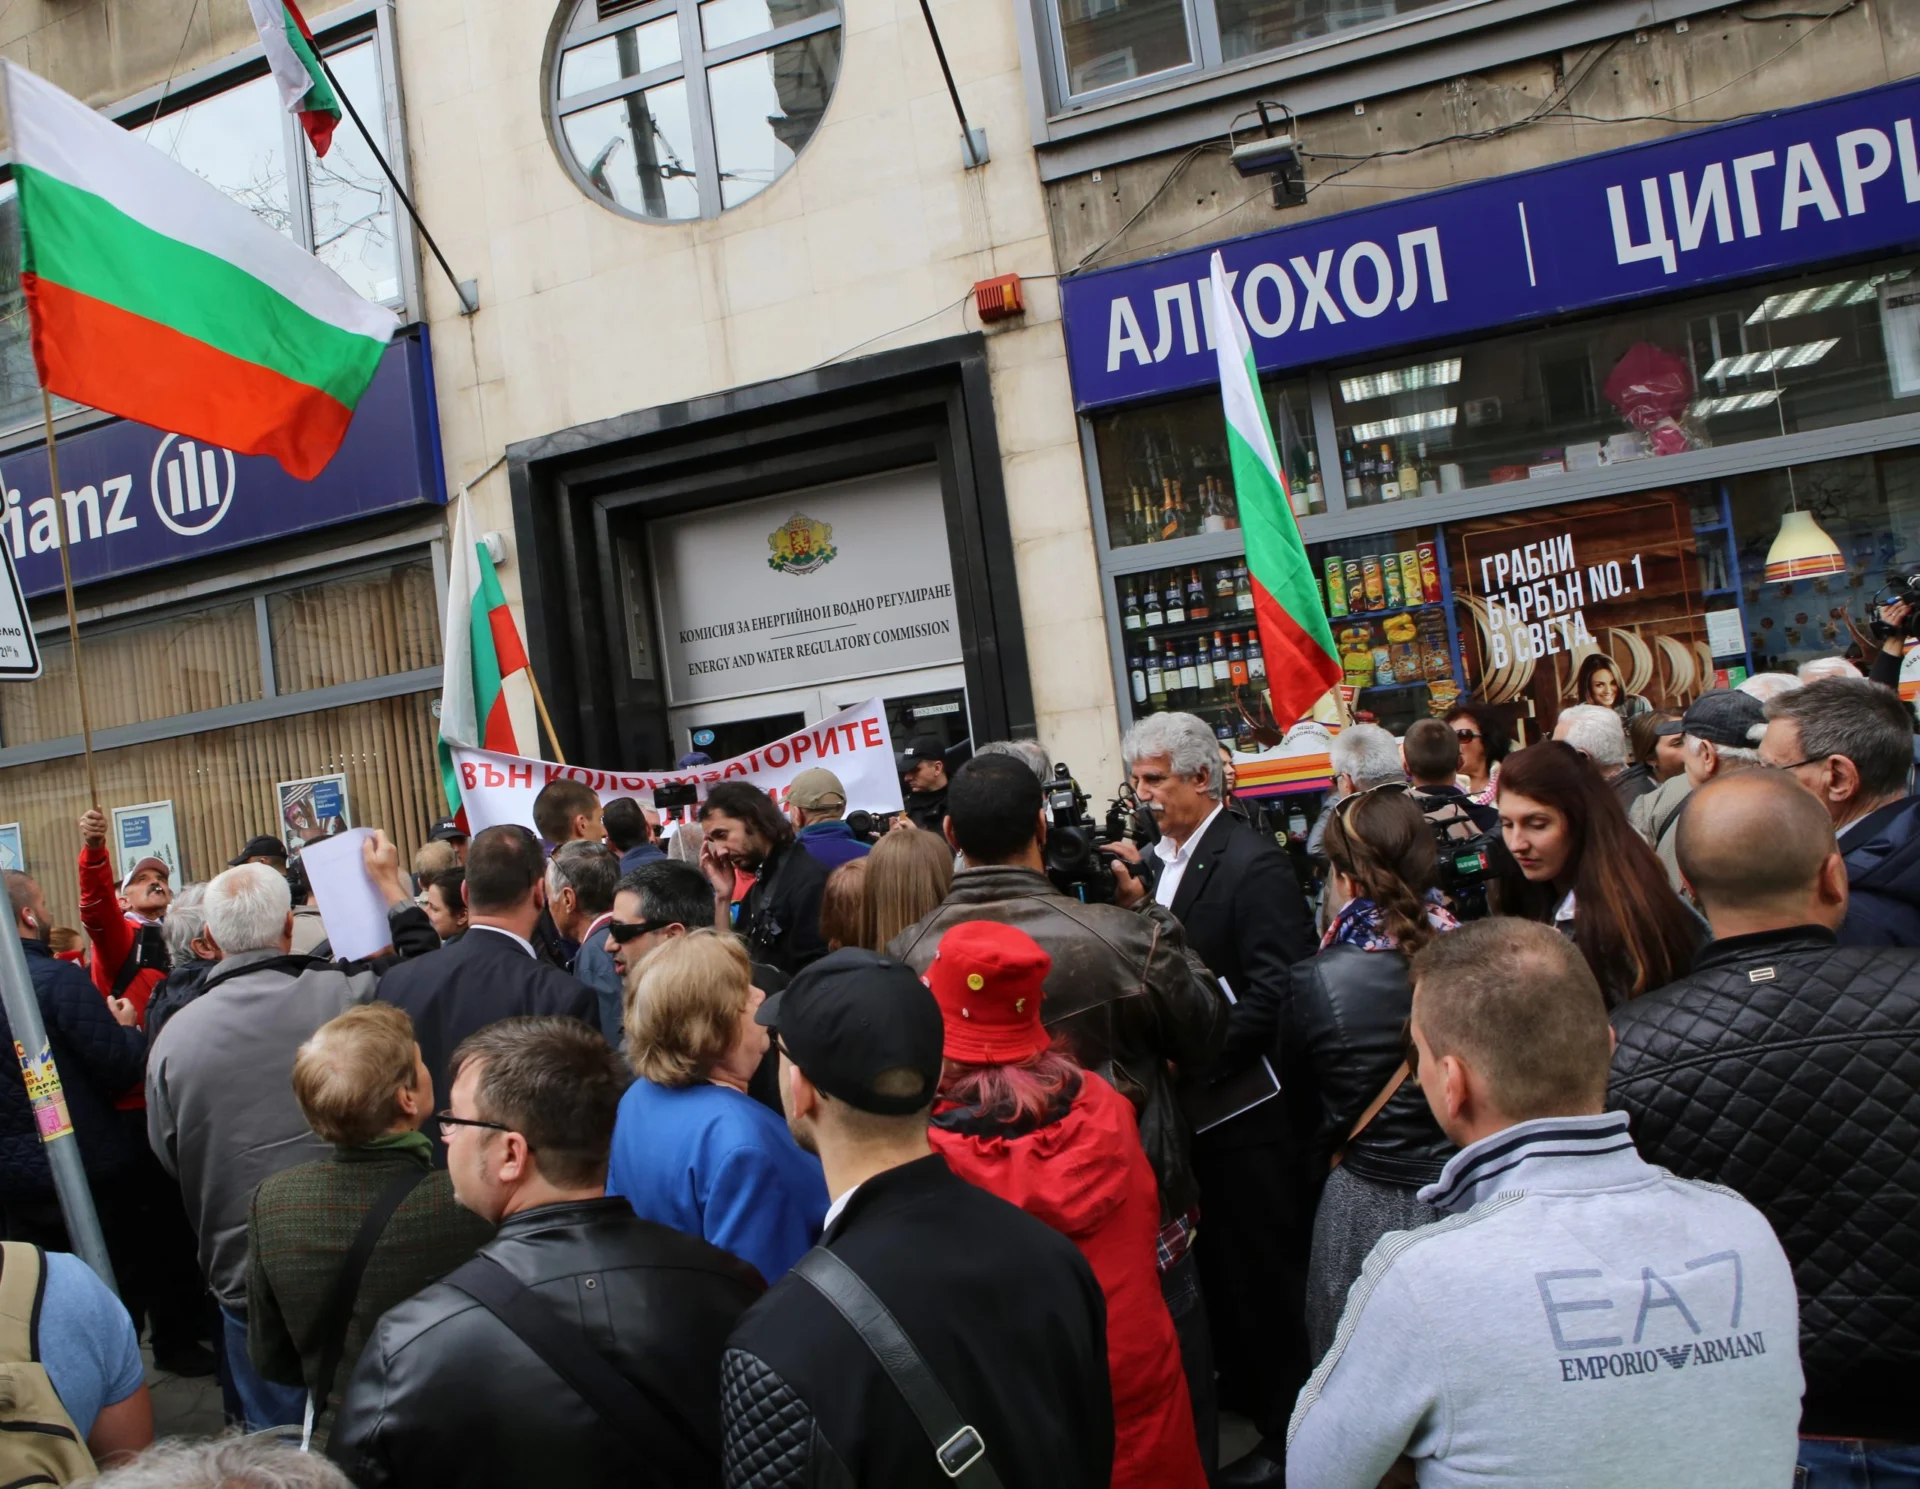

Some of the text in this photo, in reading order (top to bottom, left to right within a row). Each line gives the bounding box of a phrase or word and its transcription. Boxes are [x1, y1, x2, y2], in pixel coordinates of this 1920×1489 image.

[1107, 226, 1448, 372] АЛКОХОЛ
[4, 474, 137, 559] ianz
[1480, 533, 1575, 593] ГРАБНИ
[1486, 554, 1644, 631] БЪРБЪН NO. 1
[679, 583, 952, 644] КОМИСИЯ ЗА ЕНЕРГИЙНО И ВОДНО РЕГУЛИРАНЕ
[1491, 610, 1597, 669] В СВЕТА.
[688, 620, 950, 676] ENERGY AND WATER REGULATORY COMMISSION
[460, 762, 532, 790] ВЪН
[1535, 1249, 1743, 1351] EA7
[1559, 1331, 1767, 1382] EMPORIO ARMANI
